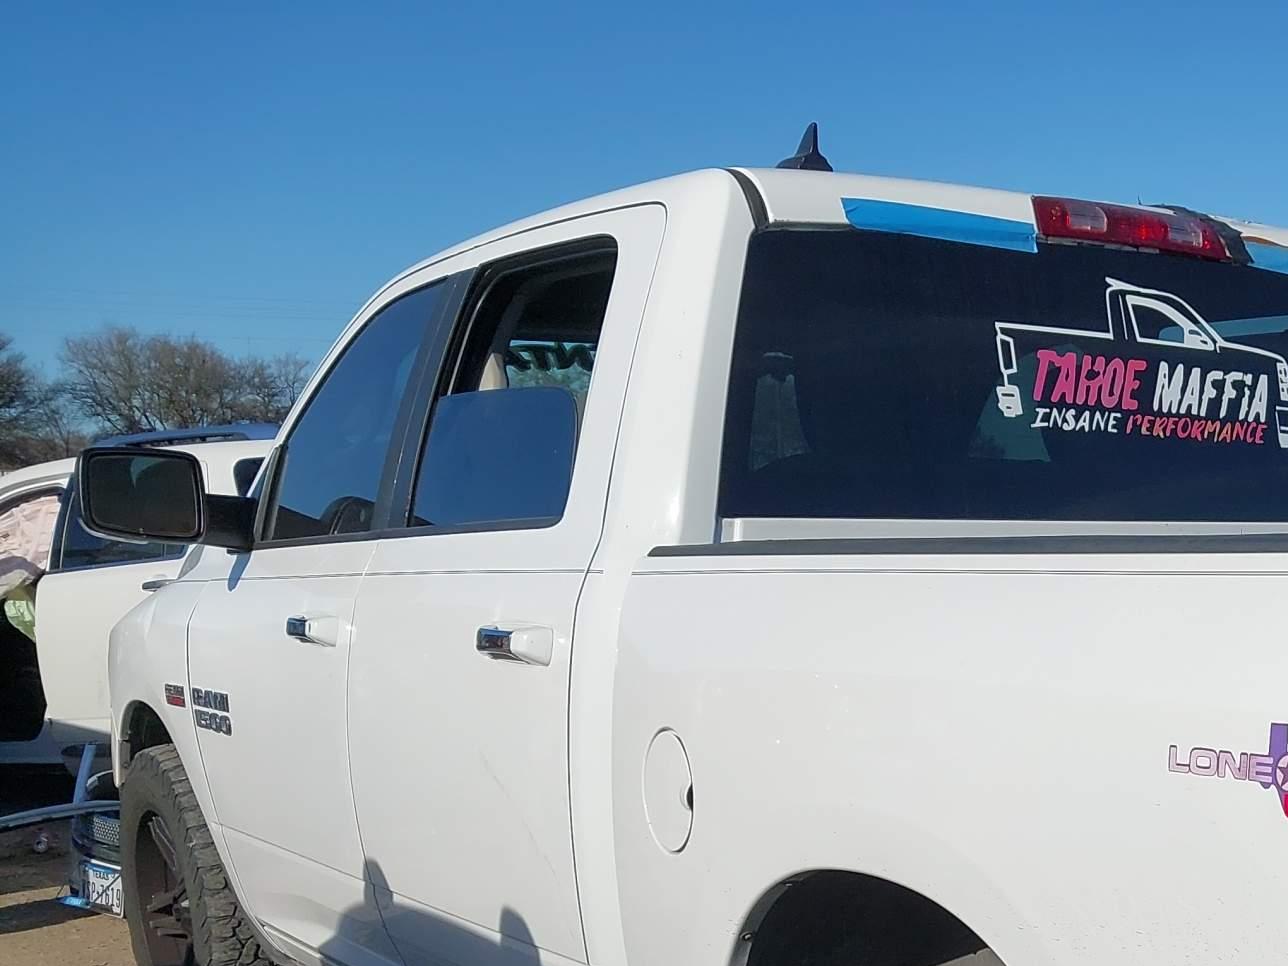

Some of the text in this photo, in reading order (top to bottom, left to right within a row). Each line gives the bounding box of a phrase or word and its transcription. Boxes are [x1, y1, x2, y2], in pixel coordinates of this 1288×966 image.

[1033, 349, 1147, 410] TAHOE
[1031, 407, 1267, 444] INSANE PERFORMANCE
[1168, 745, 1274, 783] LONE
